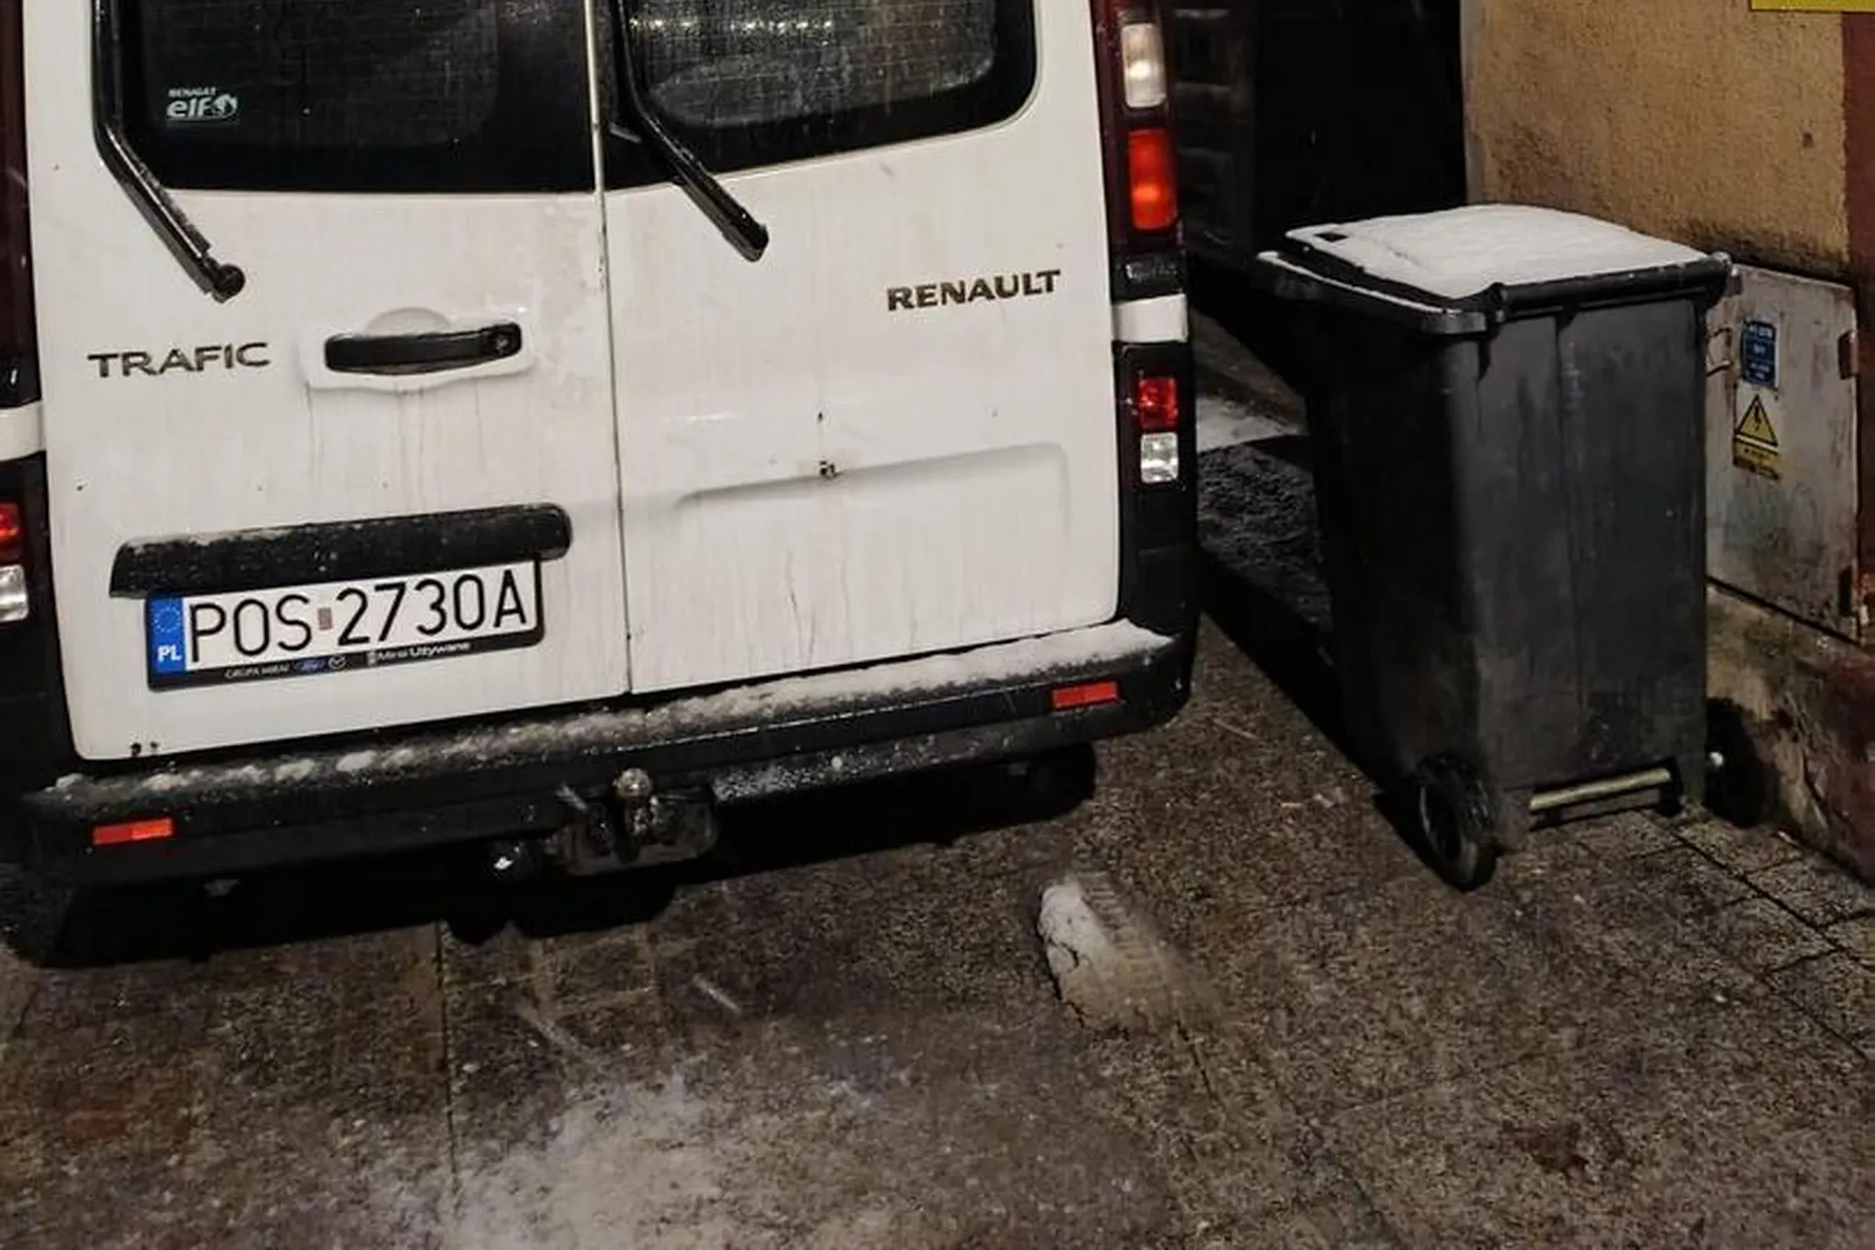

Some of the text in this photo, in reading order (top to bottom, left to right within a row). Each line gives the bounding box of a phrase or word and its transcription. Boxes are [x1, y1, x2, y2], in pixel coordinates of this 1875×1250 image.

[166, 97, 213, 118] elf
[886, 268, 1061, 311] RENAULT
[87, 342, 272, 378] TRAFIC
[189, 569, 527, 662] POS 2730A
[157, 645, 182, 662] PL
